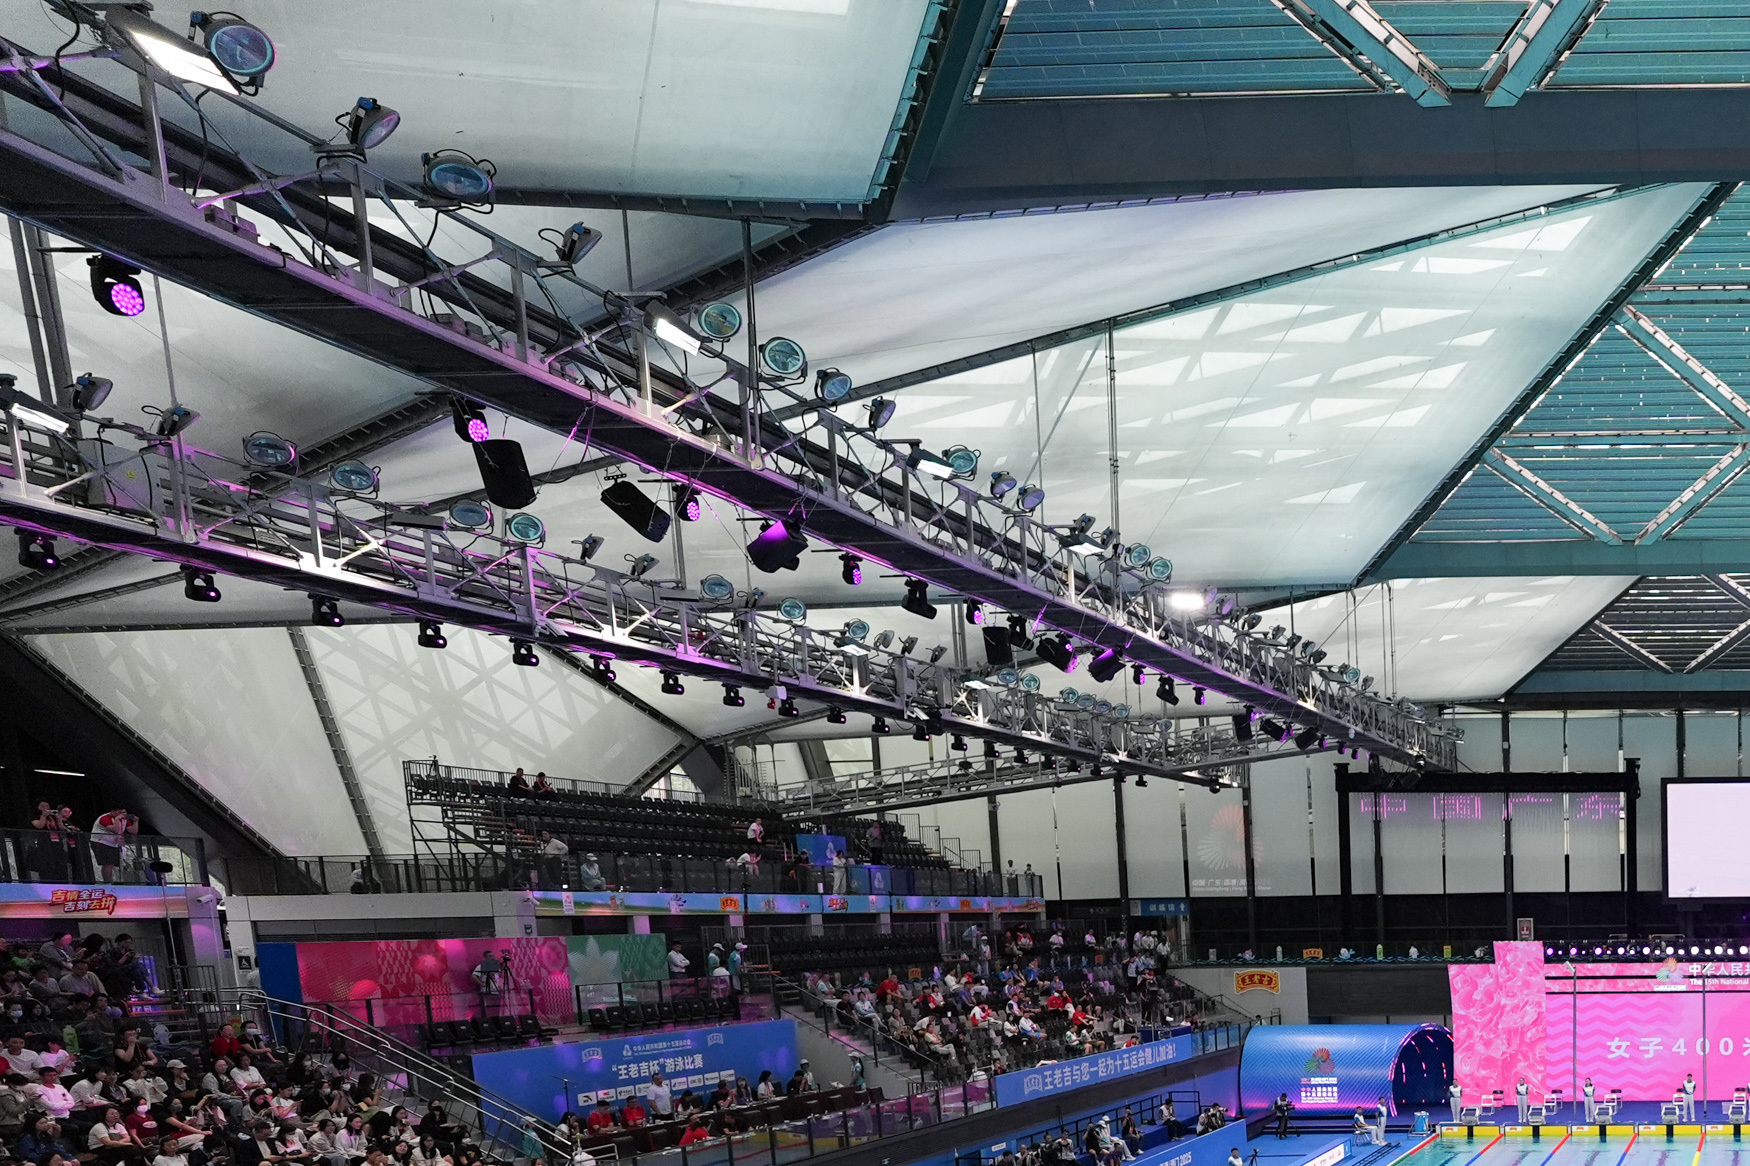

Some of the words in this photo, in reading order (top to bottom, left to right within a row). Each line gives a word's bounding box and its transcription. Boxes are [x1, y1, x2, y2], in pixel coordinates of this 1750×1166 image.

[52, 889, 105, 902] 吉情全运
[1244, 974, 1272, 985] 王老吉
[1180, 1151, 1192, 1166] 2025
